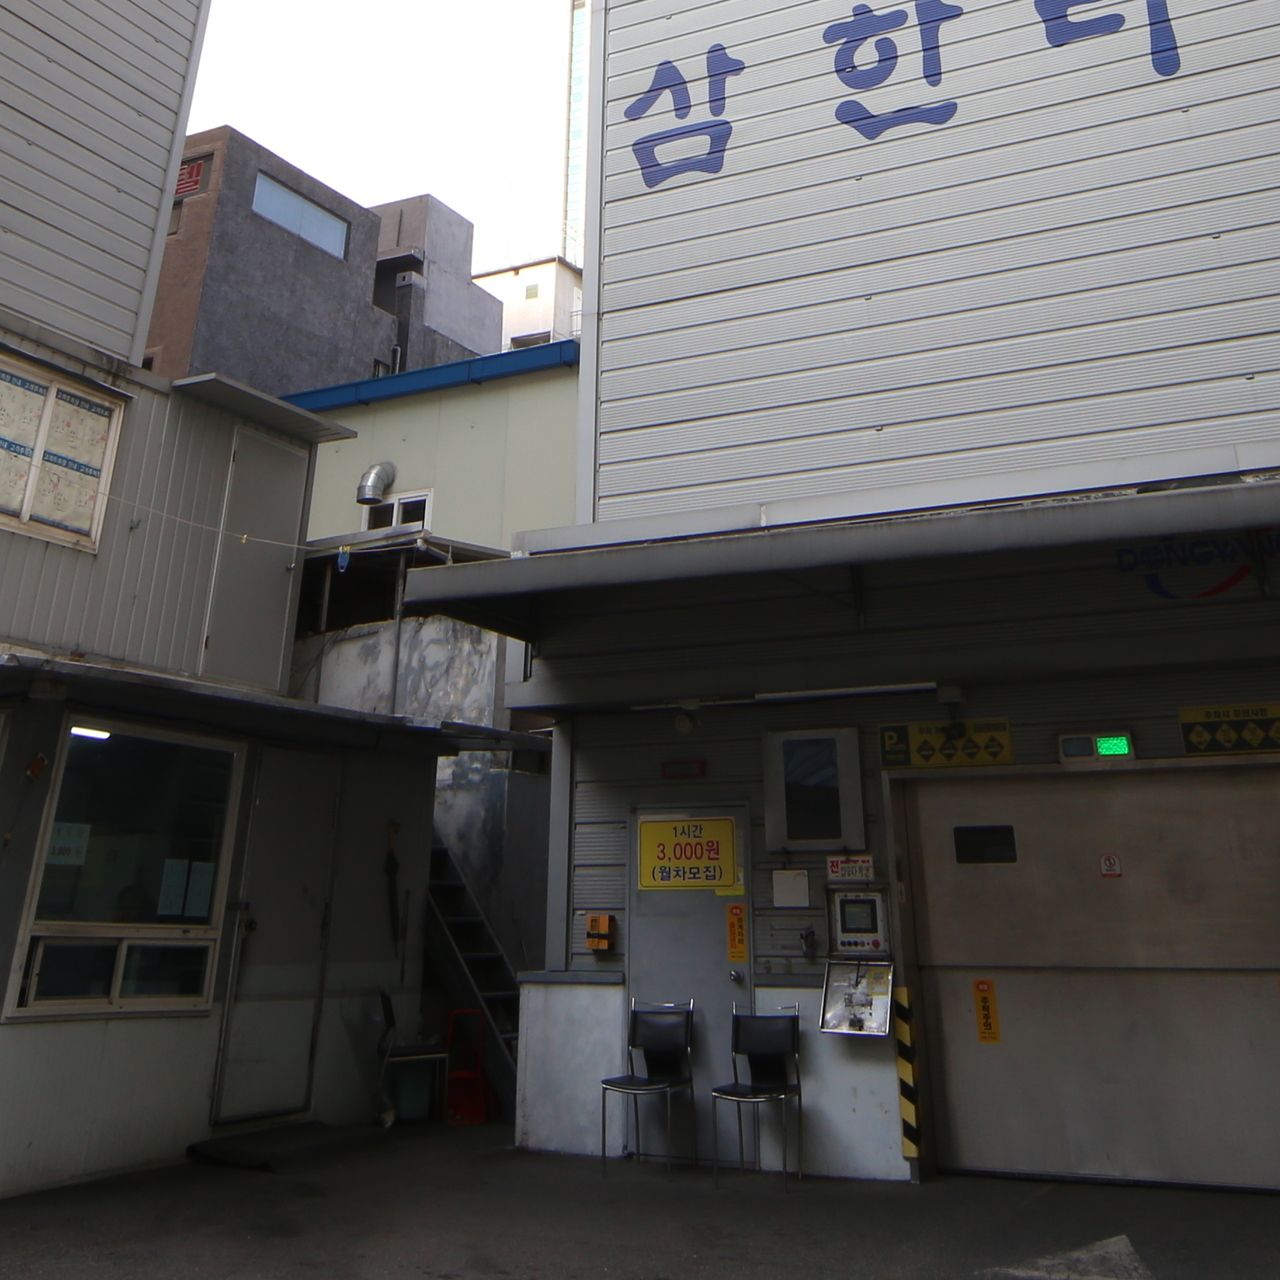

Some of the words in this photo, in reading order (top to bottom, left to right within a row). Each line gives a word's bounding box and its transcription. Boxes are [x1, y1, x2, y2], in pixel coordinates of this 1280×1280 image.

[672, 824, 704, 839] 1시간
[656, 840, 720, 862] 3,000원
[651, 864, 723, 881] (월차모집)
